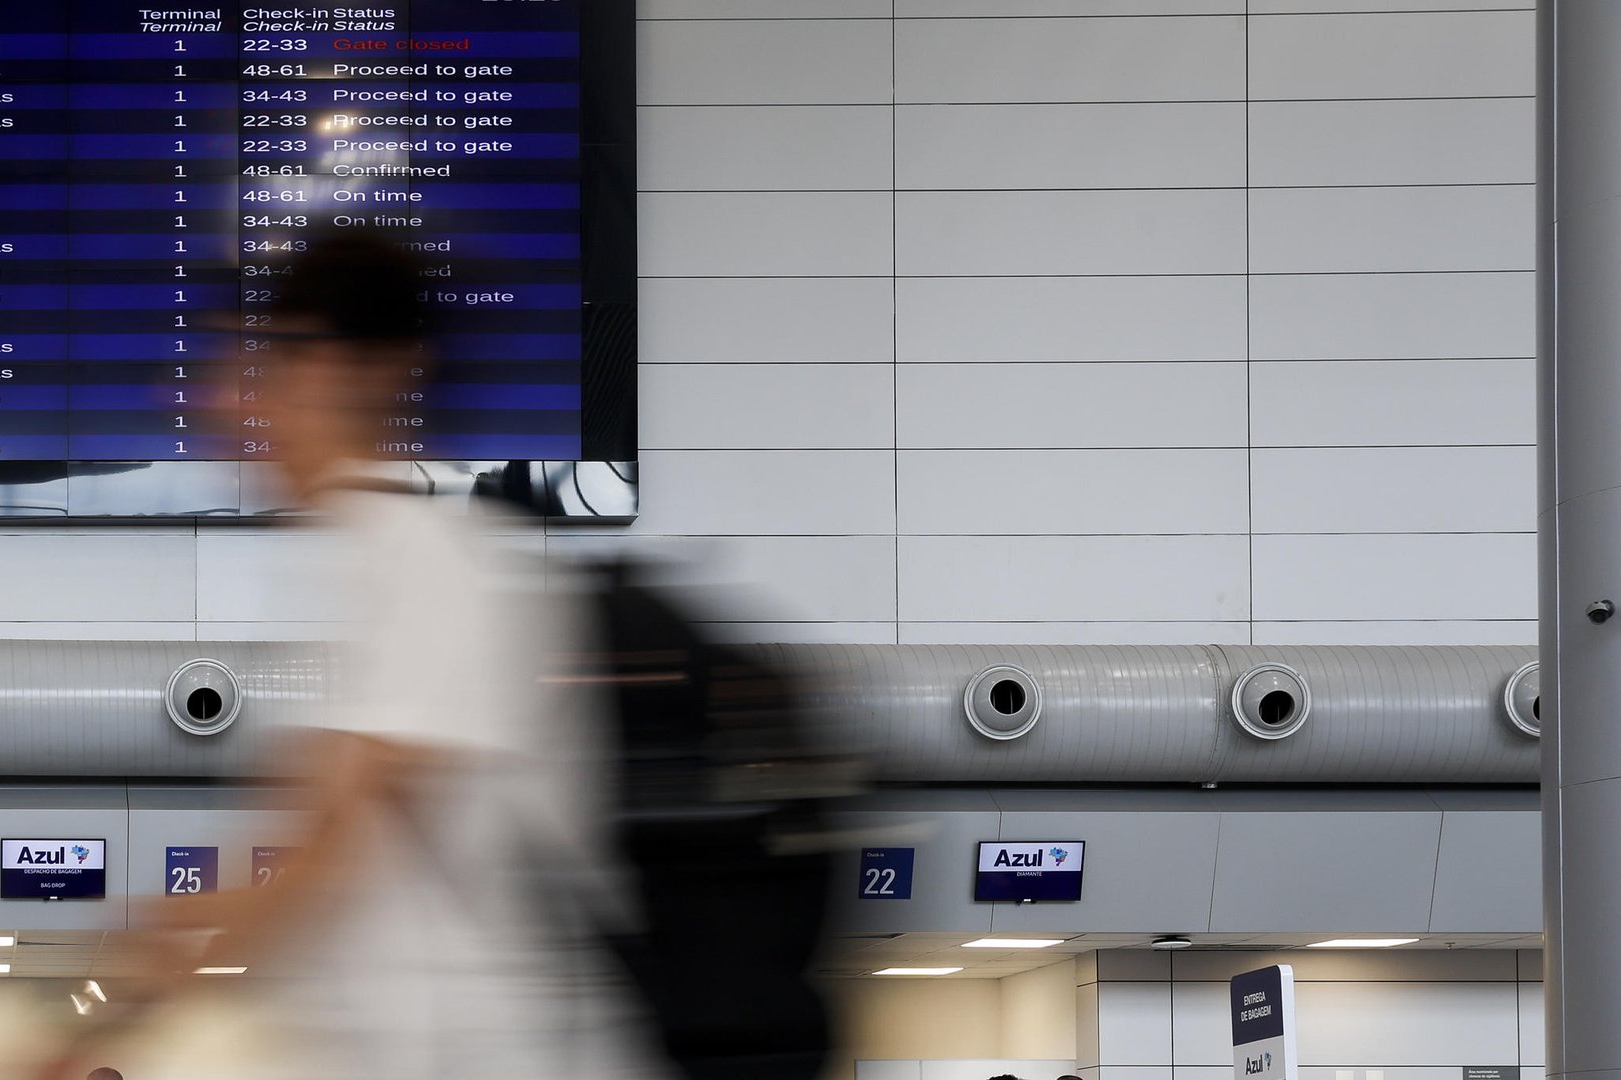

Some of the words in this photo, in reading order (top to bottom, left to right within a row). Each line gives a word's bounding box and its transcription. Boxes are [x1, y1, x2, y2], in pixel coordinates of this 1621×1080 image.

[139, 9, 220, 19] Terminal
[244, 8, 328, 18] Check-in
[334, 9, 394, 18] Status
[141, 22, 221, 32] Terminal
[244, 21, 328, 31] Check-in
[333, 21, 394, 30] Status
[175, 40, 186, 51] 1
[244, 39, 307, 50] 22-33
[332, 38, 388, 51] Gate
[395, 38, 470, 51] closed
[175, 91, 186, 101] 1
[244, 91, 306, 101] 34-43
[334, 90, 427, 101] Proceed
[436, 91, 455, 101] to
[465, 91, 512, 103] gate
[175, 191, 186, 201] 1
[243, 190, 307, 202] 48-61
[333, 190, 365, 202] On
[374, 190, 422, 201] time
[17, 847, 64, 864] Azul
[994, 849, 1043, 867] Azul
[172, 868, 200, 893] 25
[865, 869, 895, 894] 22
[1243, 991, 1266, 1006] ENTREGA
[1240, 1010, 1249, 1022] DE
[1248, 1004, 1272, 1020] BAGAGEM
[1246, 1055, 1263, 1075] Azul
